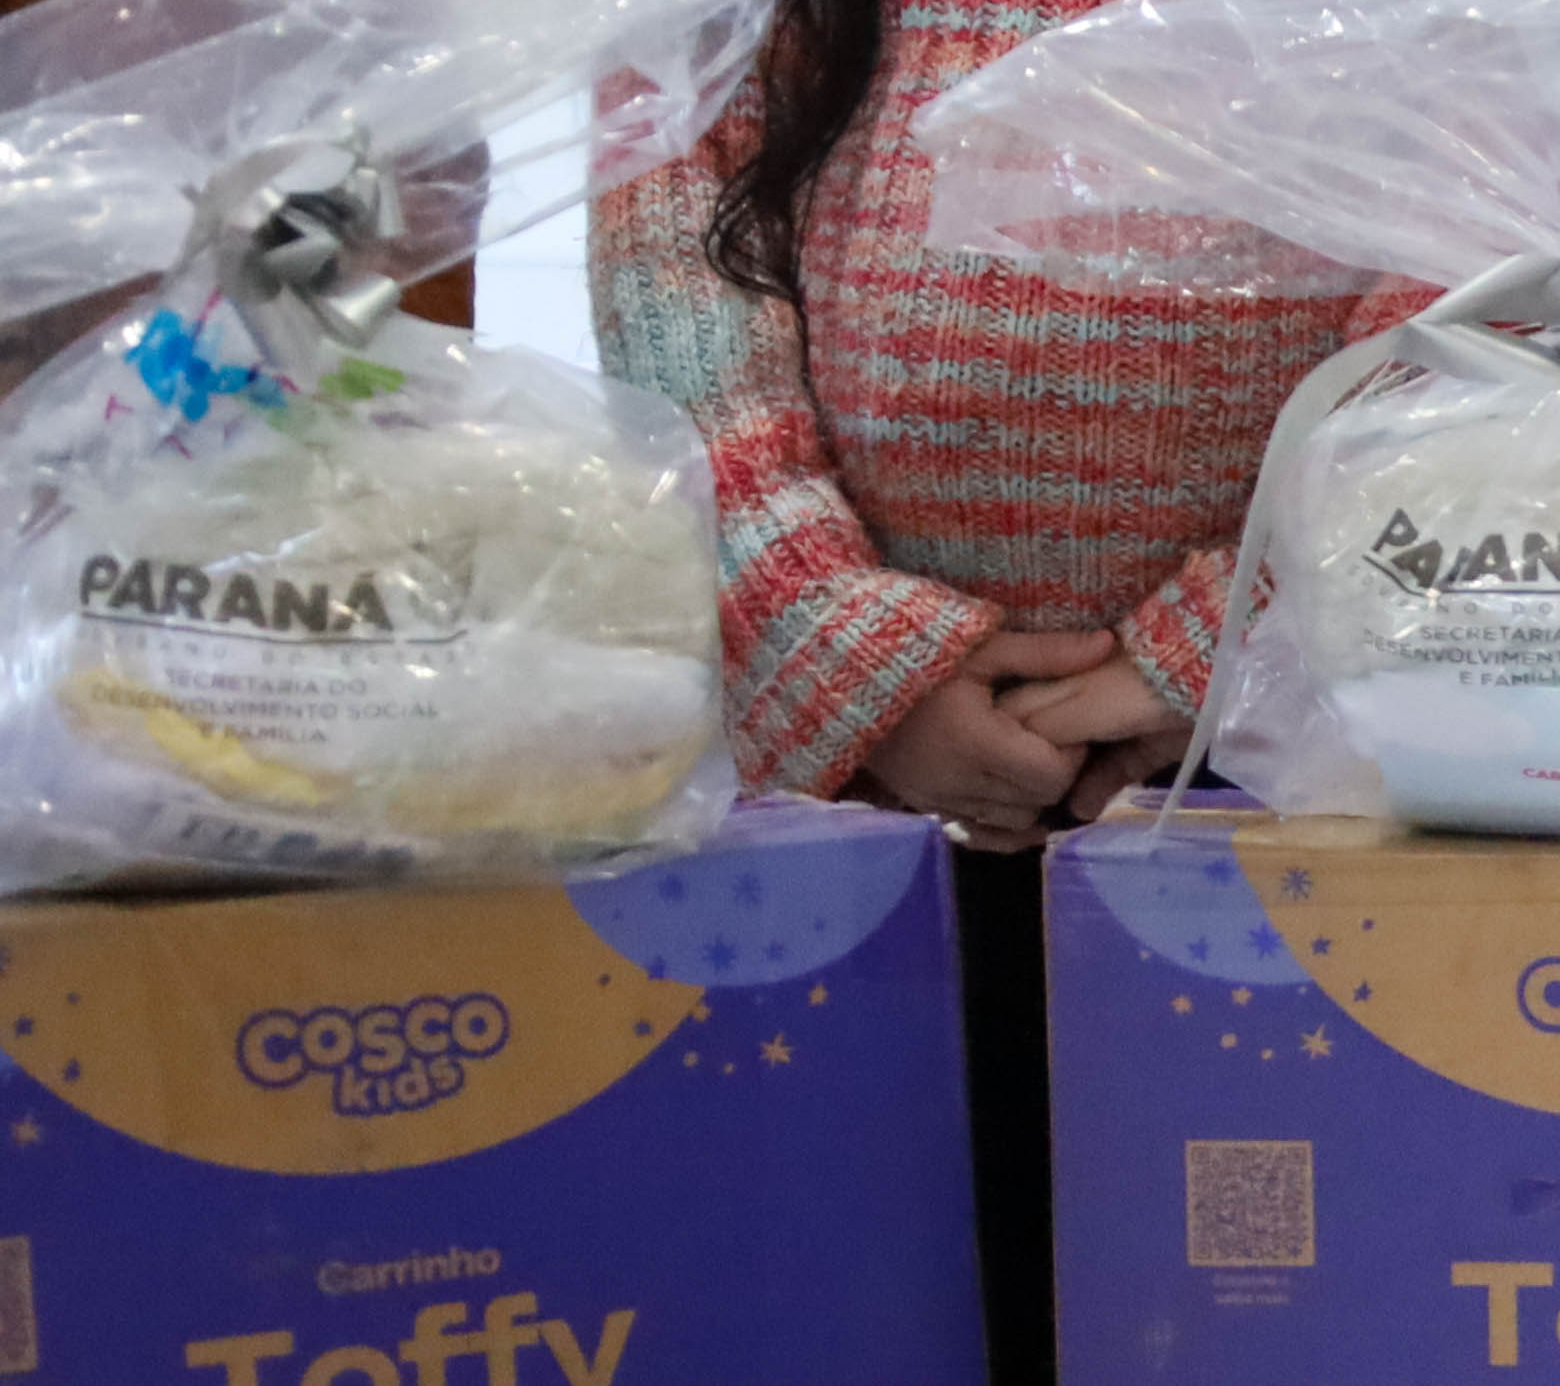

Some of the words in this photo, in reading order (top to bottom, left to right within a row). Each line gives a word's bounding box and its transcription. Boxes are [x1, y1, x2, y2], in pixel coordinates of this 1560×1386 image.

[1459, 671, 1473, 686] E
[333, 1055, 467, 1119] kids
[318, 1244, 502, 1295] Carrinho
